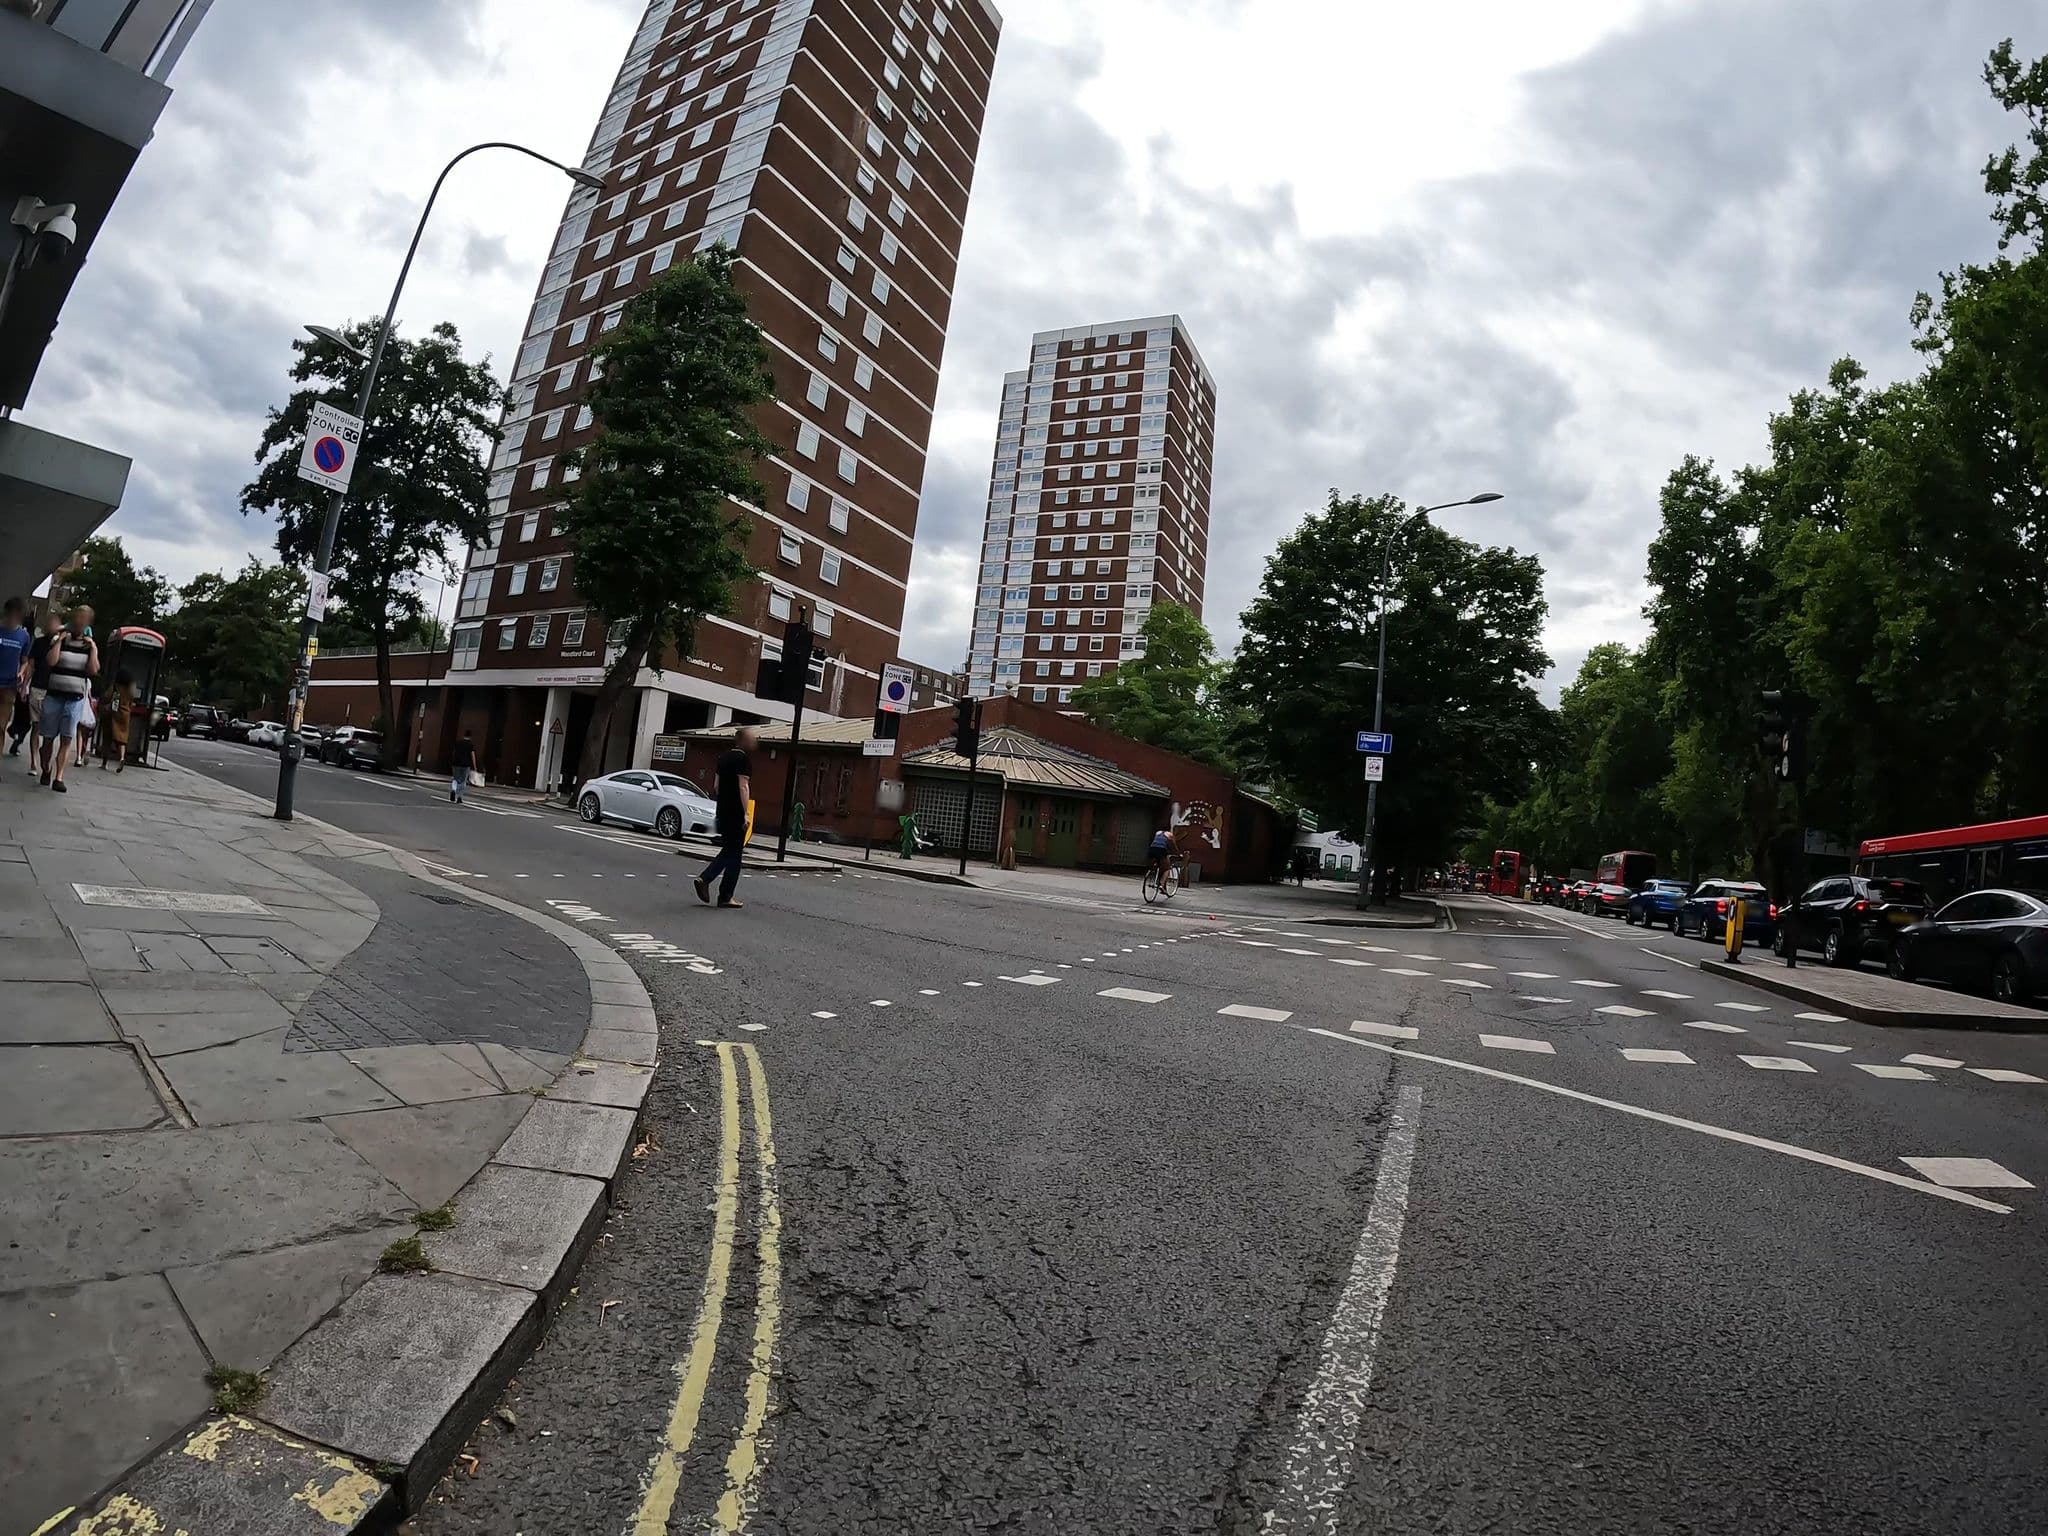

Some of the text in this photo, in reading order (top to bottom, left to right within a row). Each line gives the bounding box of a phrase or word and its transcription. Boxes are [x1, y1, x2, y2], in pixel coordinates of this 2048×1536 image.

[319, 407, 360, 429] Controlled
[312, 416, 359, 443] ZONE CC
[309, 639, 318, 654] H
[884, 671, 901, 680] ZONE
[545, 899, 618, 922] LOOK
[608, 932, 716, 964] RIGHT
